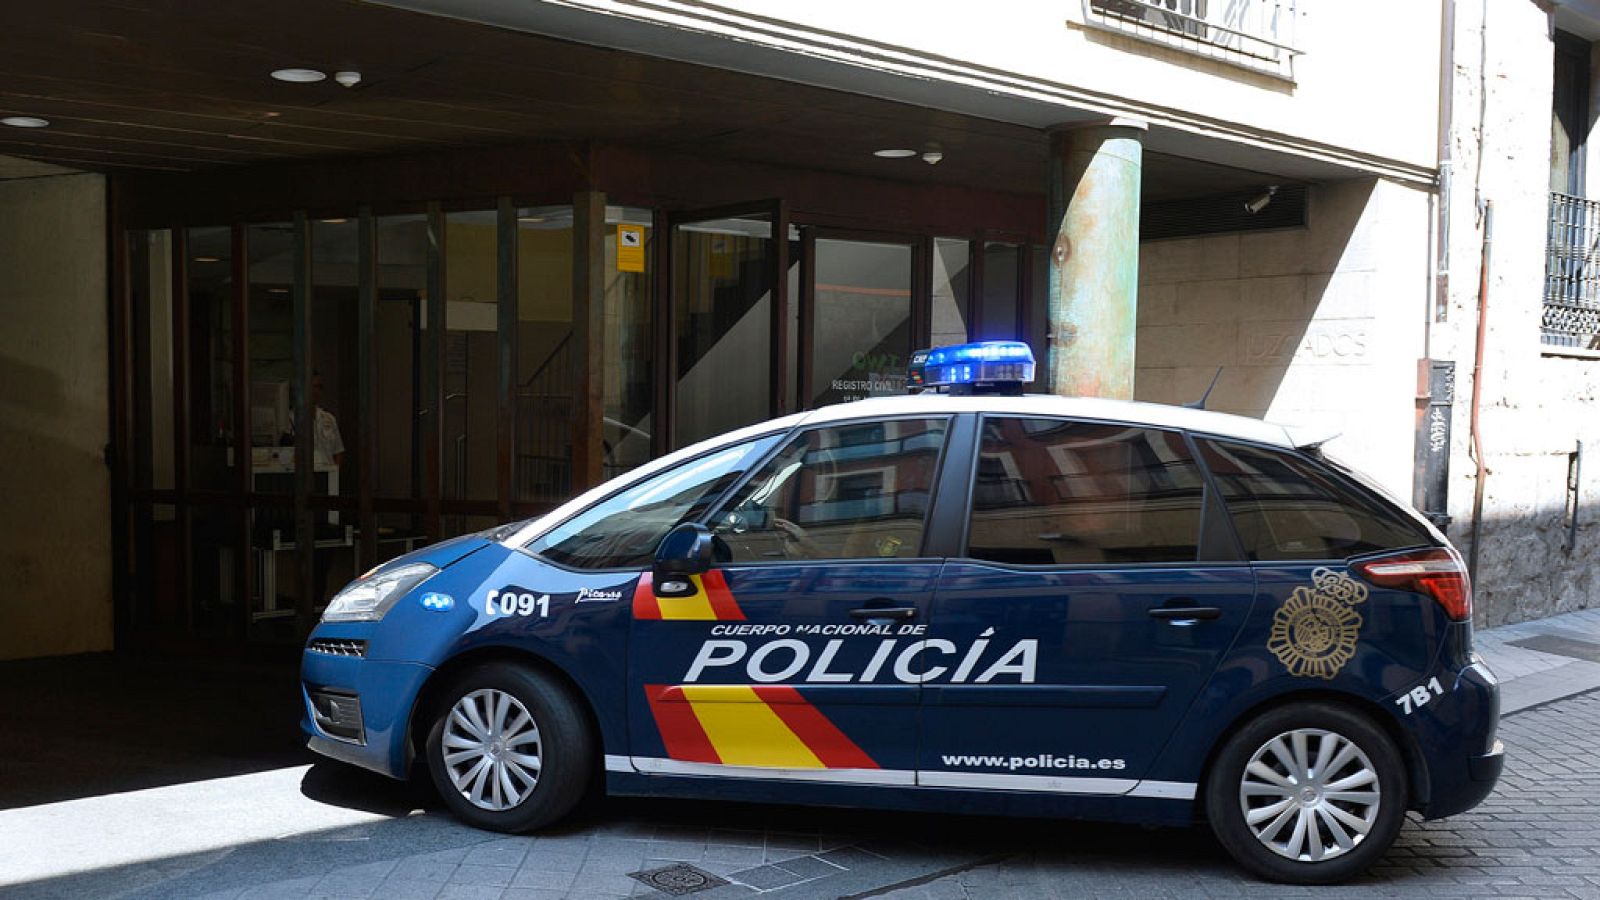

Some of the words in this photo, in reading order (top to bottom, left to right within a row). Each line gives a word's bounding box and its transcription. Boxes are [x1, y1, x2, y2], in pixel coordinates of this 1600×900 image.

[832, 379, 872, 392] REGISTRO
[500, 591, 550, 617] 091
[711, 624, 791, 636] CUERPO
[795, 624, 893, 636] NACIONAL
[897, 624, 928, 636] DE
[682, 626, 1039, 683] POLICÍA
[1395, 676, 1444, 714] 7B1
[941, 754, 1126, 770] www.policia.es
